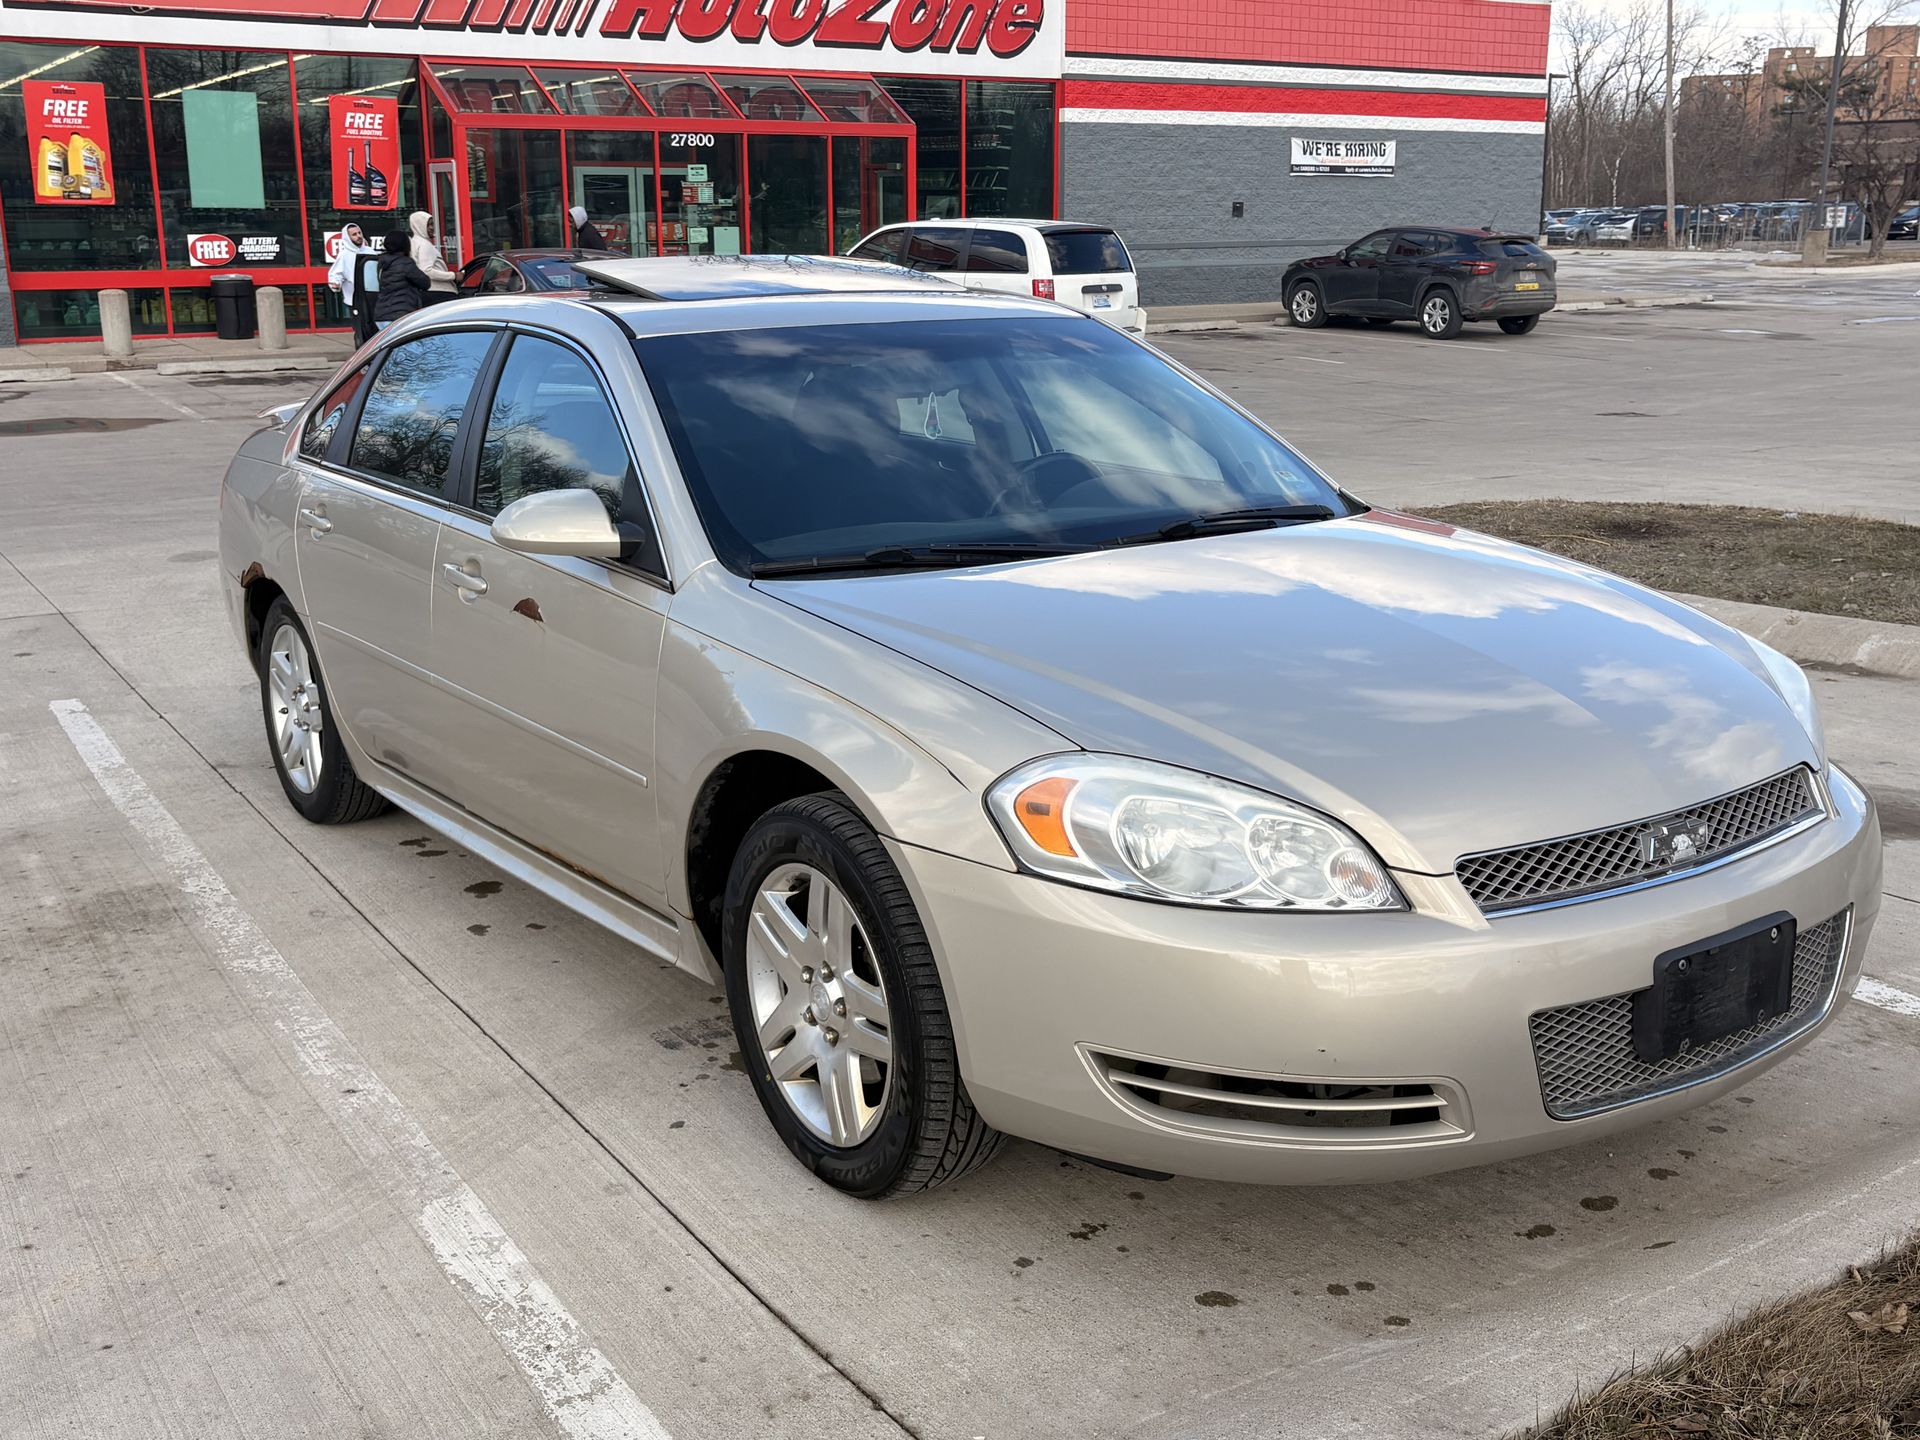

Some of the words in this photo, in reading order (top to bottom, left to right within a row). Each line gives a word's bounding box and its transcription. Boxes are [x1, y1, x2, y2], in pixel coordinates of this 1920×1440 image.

[43, 99, 89, 117] FREE
[345, 112, 384, 129] FREE
[670, 133, 715, 147] 27800
[1302, 140, 1342, 157] WE'RE
[1345, 142, 1387, 158] HIRING
[238, 244, 280, 253] CHARGING
[242, 236, 278, 245] BATTERY
[195, 241, 230, 259] FREE
